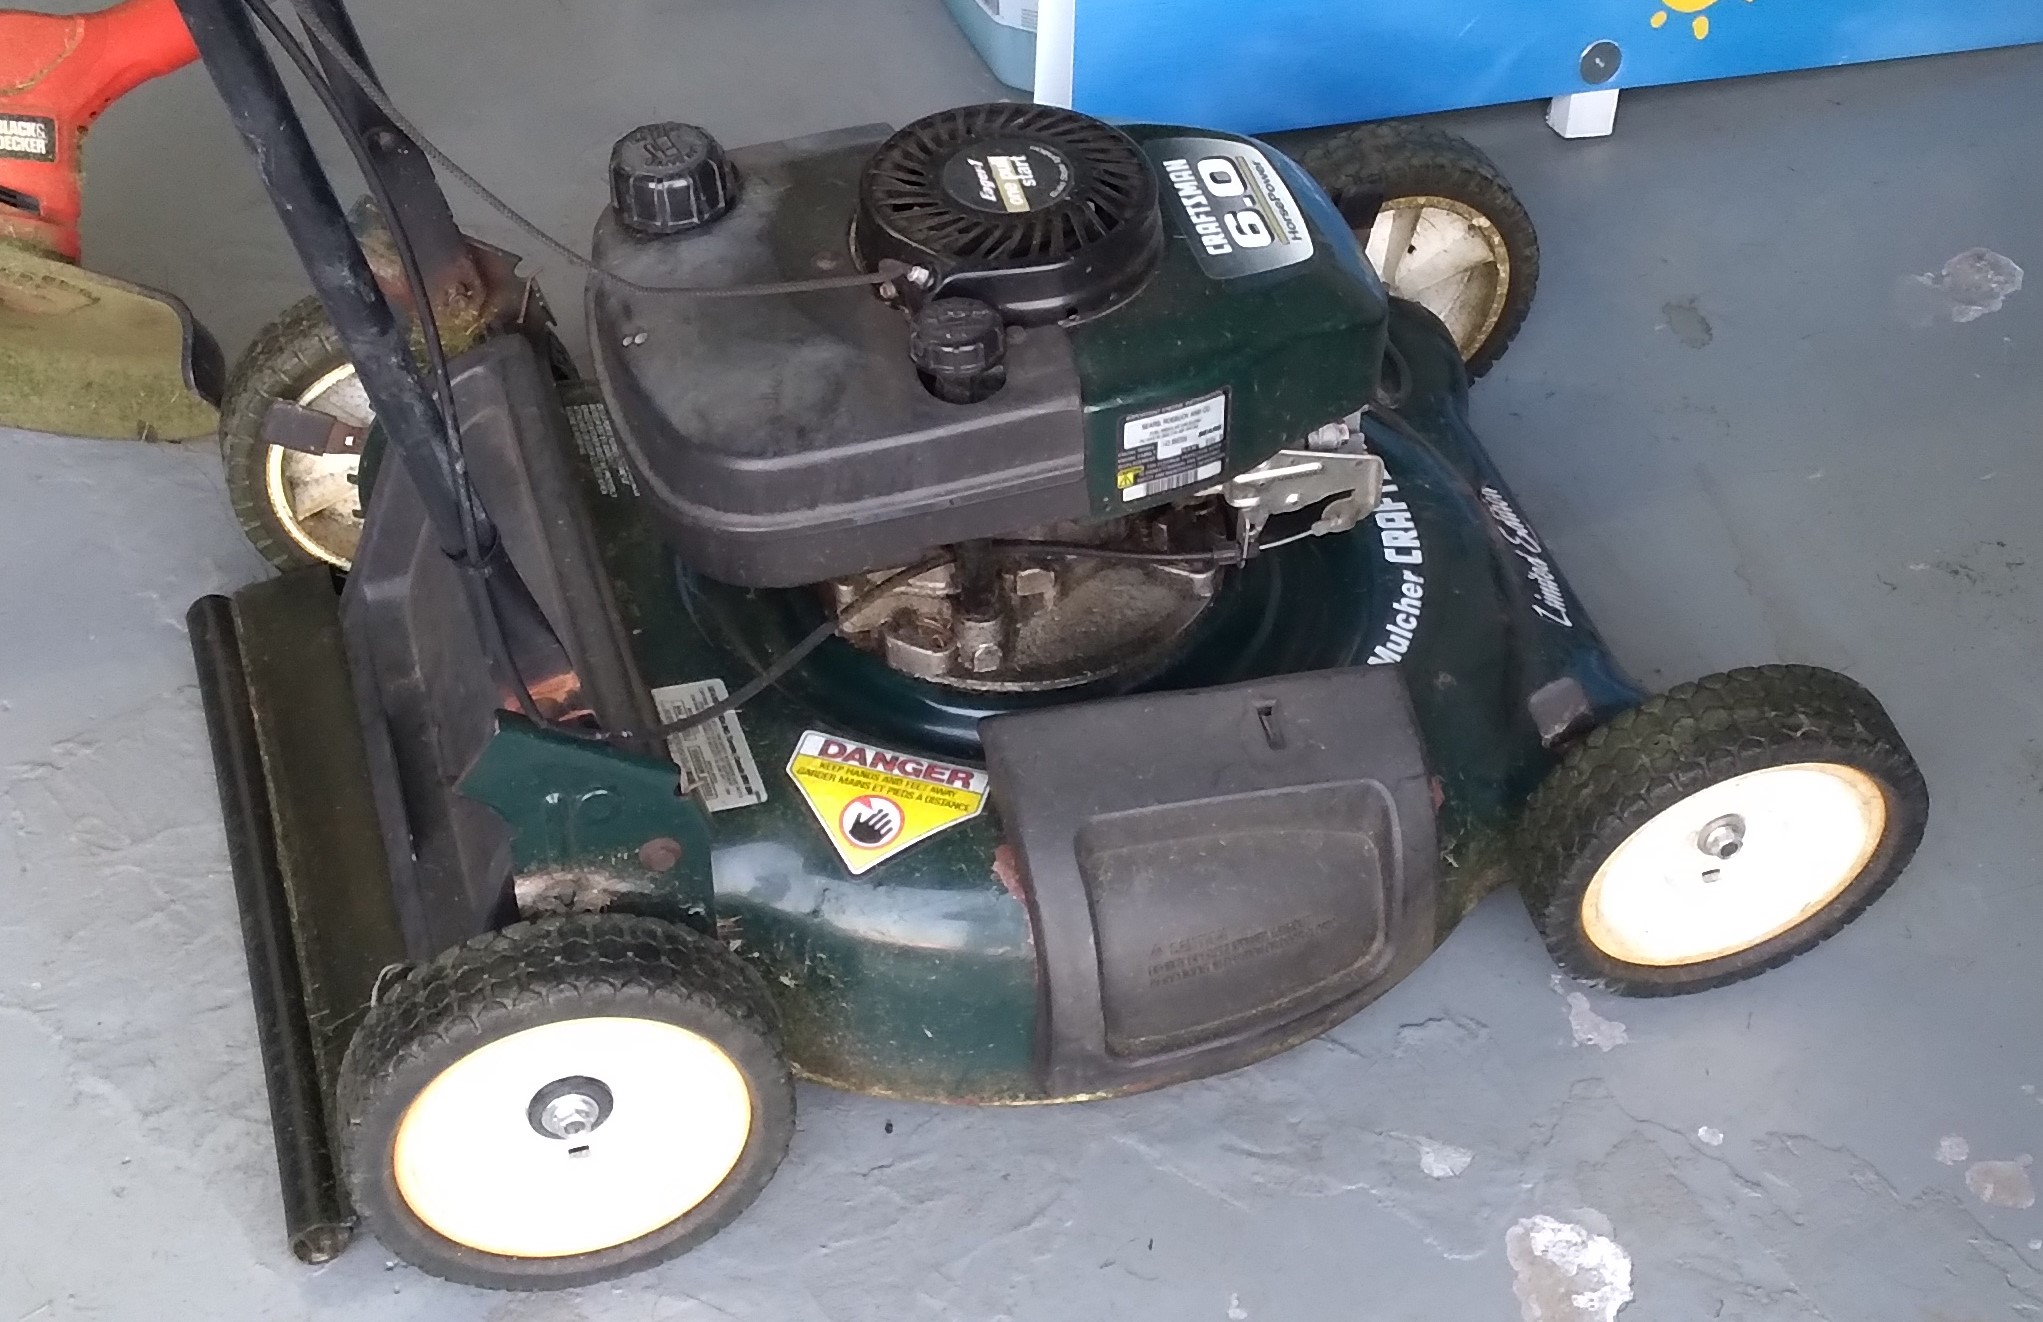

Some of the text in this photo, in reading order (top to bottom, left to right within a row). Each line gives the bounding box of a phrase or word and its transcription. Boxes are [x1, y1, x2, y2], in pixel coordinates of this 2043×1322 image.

[1003, 182, 1025, 205] one
[1009, 155, 1036, 187] start
[1162, 158, 1233, 256] CRAFTSMAN
[1197, 156, 1275, 249] 6.0
[1252, 160, 1303, 242] HorsePower
[1515, 550, 1573, 627] Limited
[796, 766, 837, 782] GARDER
[838, 776, 872, 790] MAINS
[872, 783, 886, 793] ET
[886, 786, 915, 800] PIEDS
[924, 796, 969, 812] DISTANCE
[818, 739, 975, 790] DANGER
[819, 762, 956, 798] KEEP HANDS AND FEET AWAY
